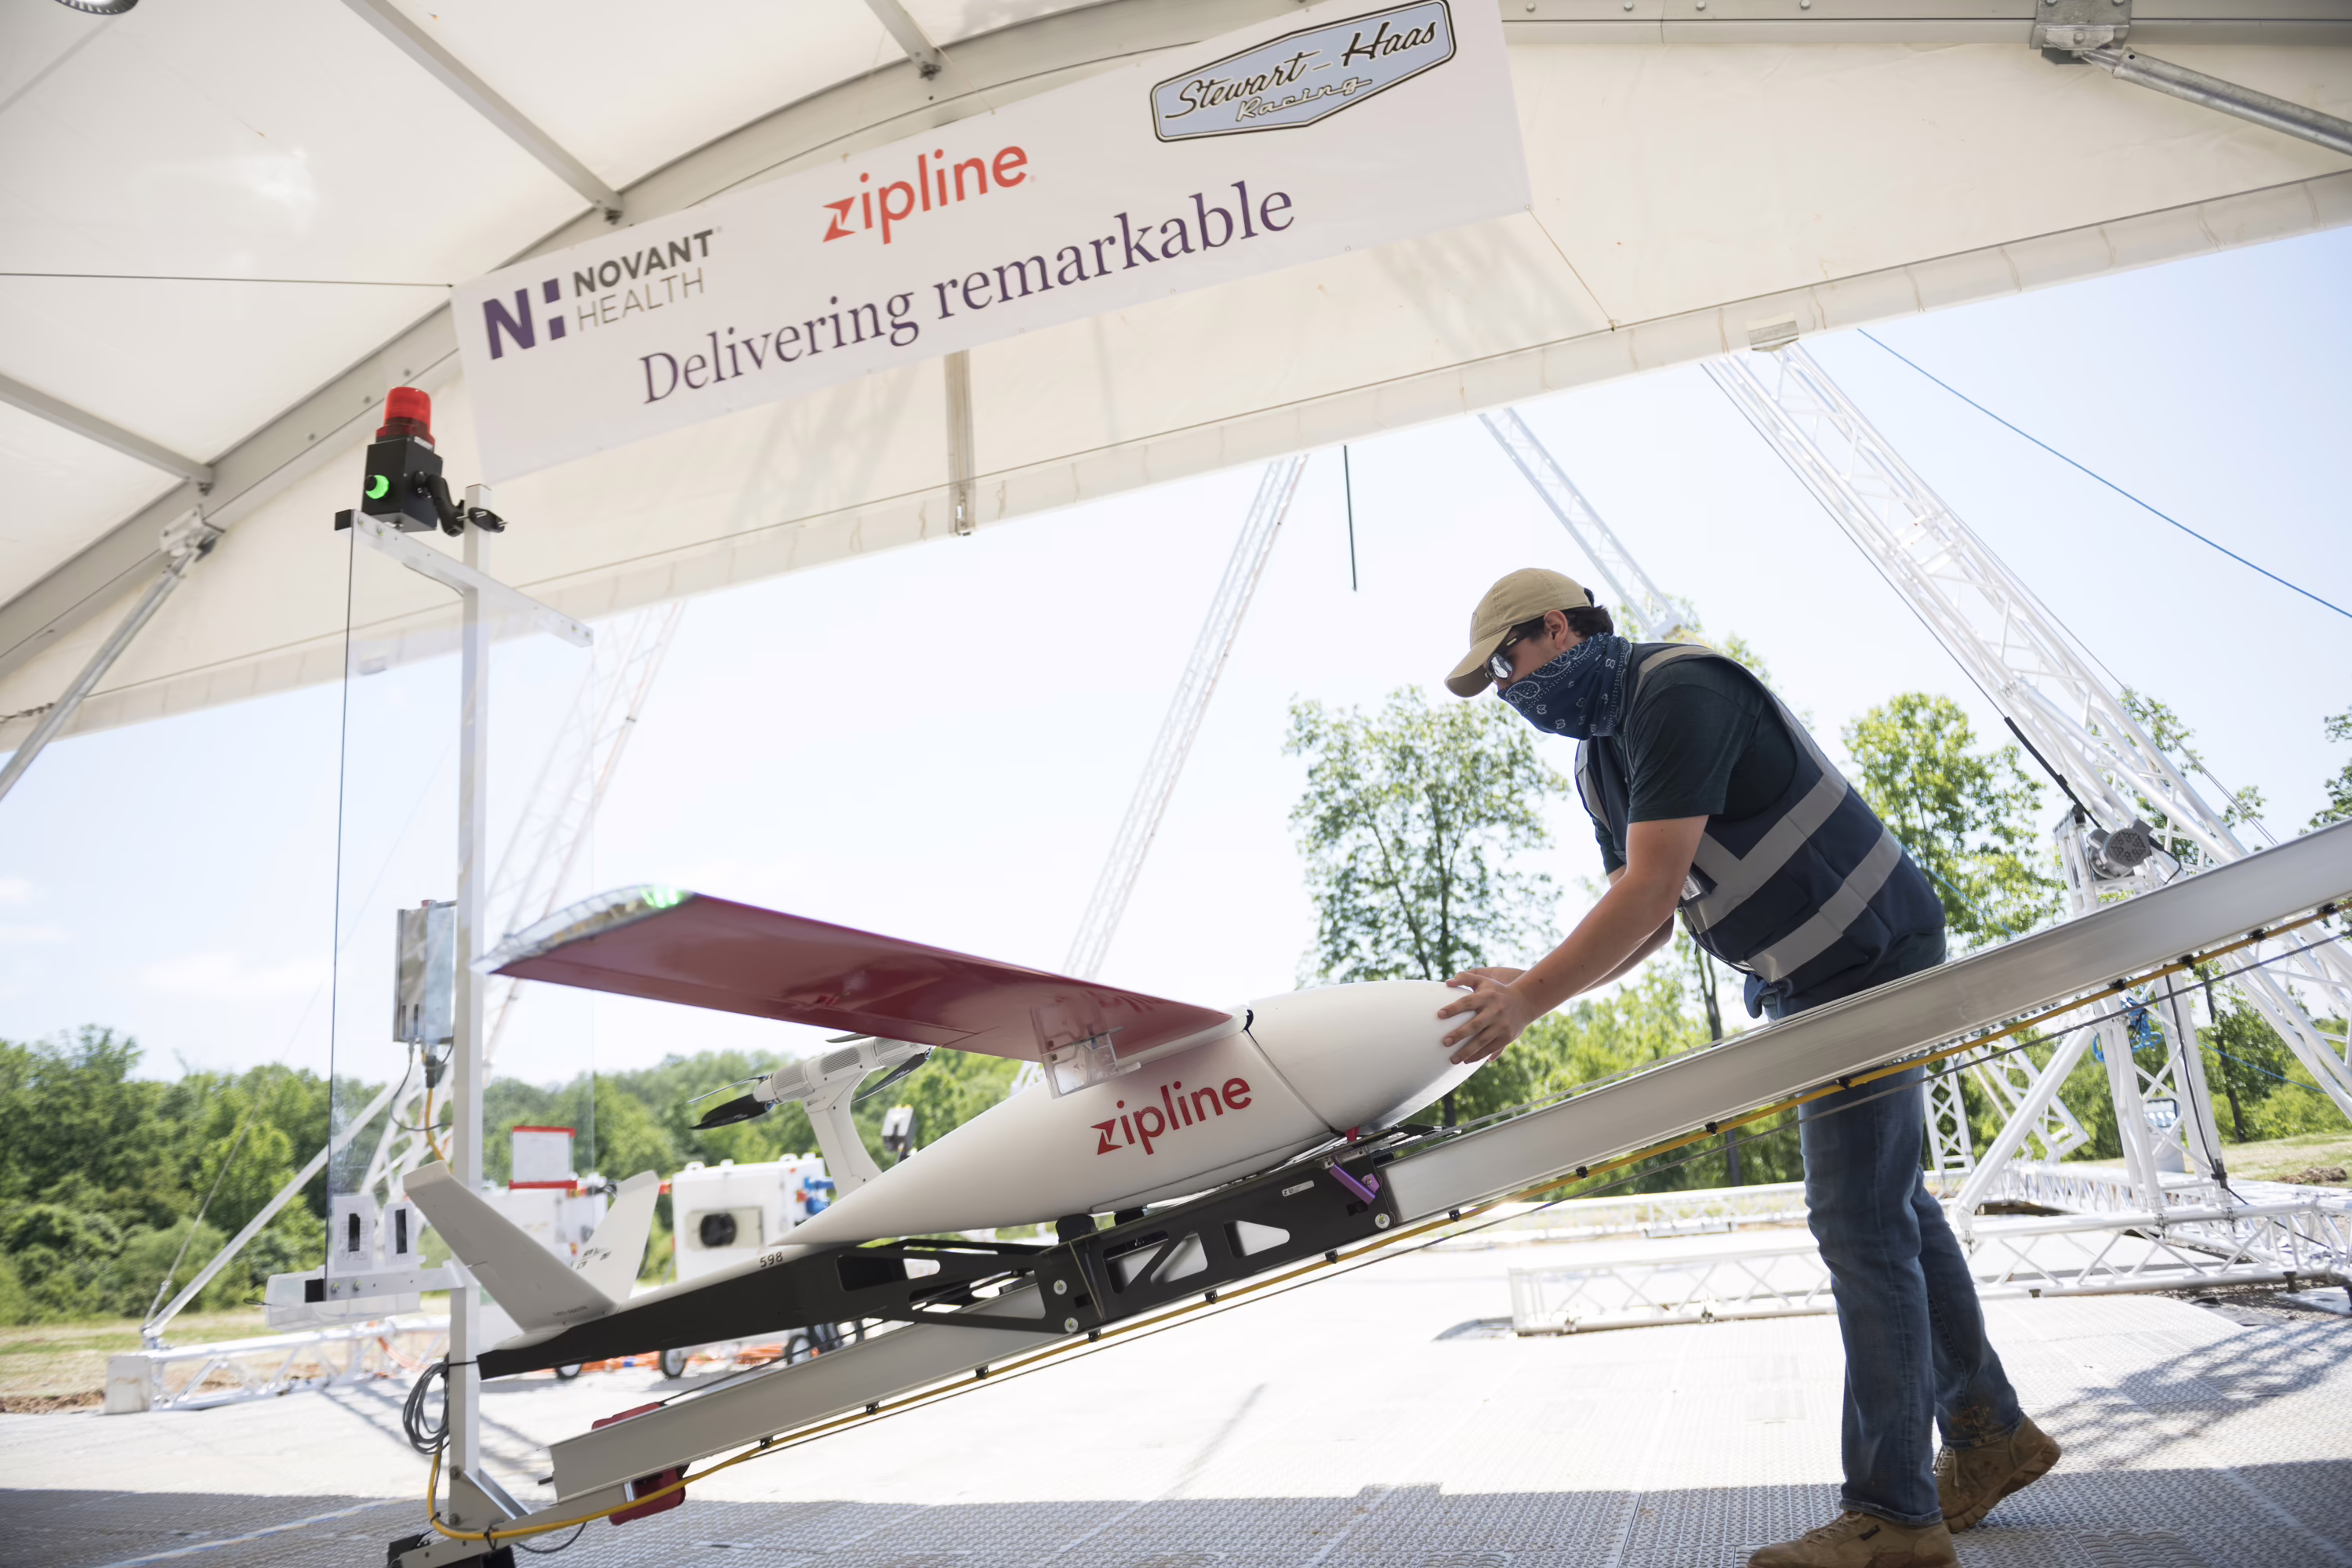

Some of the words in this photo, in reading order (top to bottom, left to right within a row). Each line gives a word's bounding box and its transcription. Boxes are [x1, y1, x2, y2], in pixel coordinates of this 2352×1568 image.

[1236, 77, 1373, 122] Racing
[822, 146, 1028, 245] zipline
[573, 229, 713, 297] NOVANT
[639, 291, 919, 404] Delivering
[933, 181, 1294, 320] remarkable
[577, 267, 703, 332] HEALTH
[1091, 1078, 1252, 1156] zipline
[760, 1251, 783, 1268] 598
